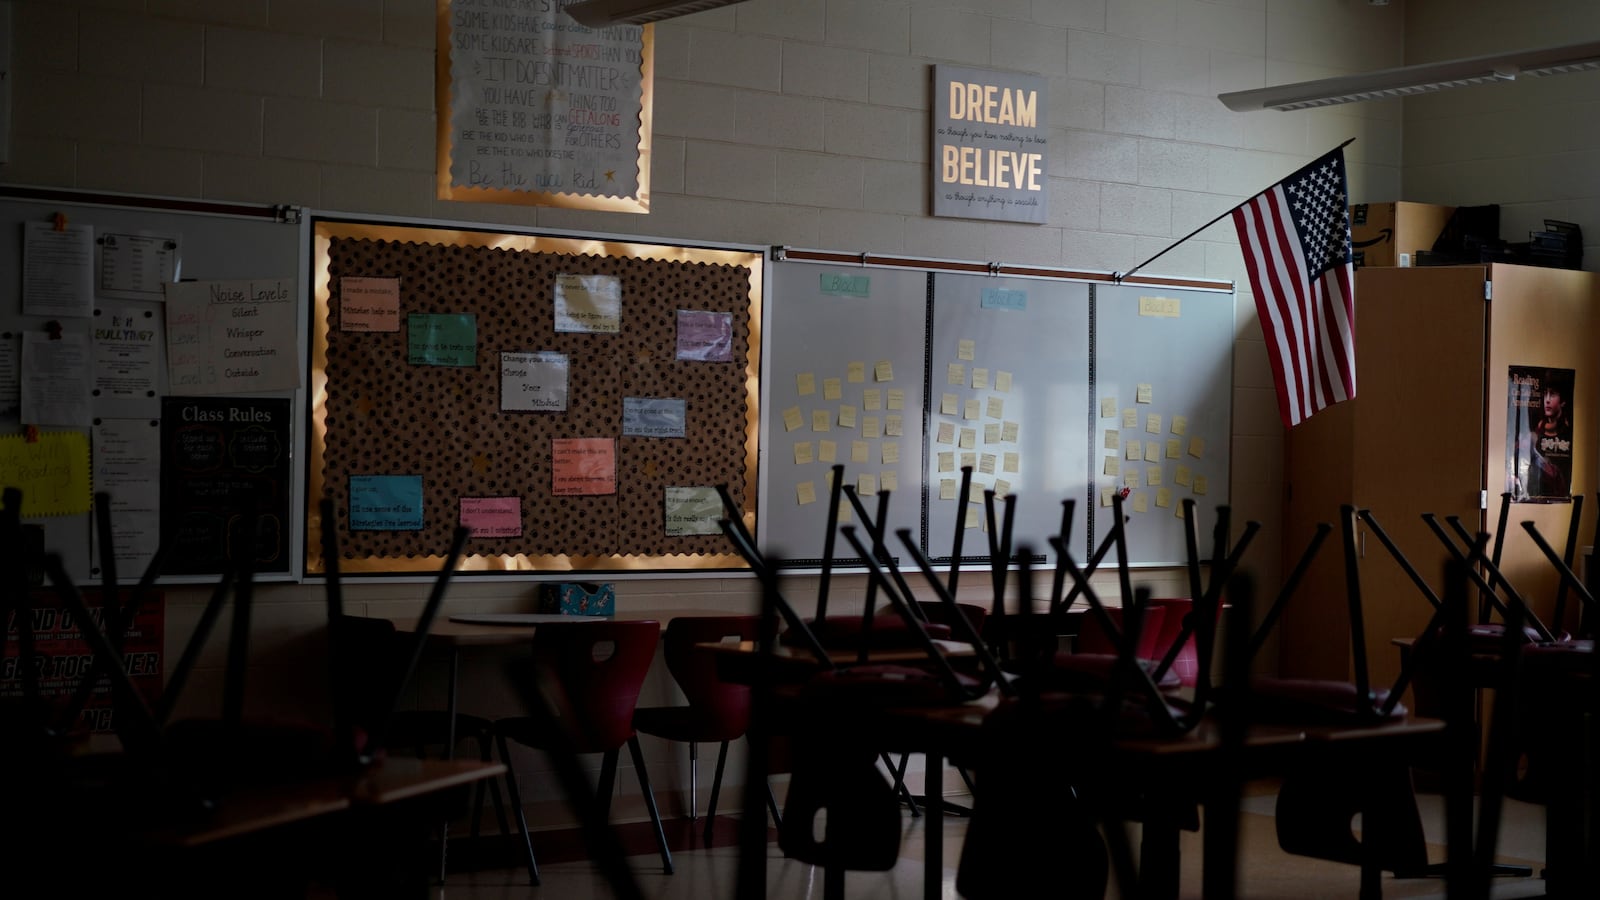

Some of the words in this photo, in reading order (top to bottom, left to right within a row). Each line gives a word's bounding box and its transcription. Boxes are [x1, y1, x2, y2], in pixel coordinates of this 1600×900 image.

[456, 10, 488, 30] SOME
[492, 14, 516, 32] KIDS
[624, 26, 641, 43] YOU
[456, 32, 488, 51] SOME
[491, 35, 515, 53] KIDS
[624, 47, 641, 65] YOU
[483, 57, 512, 82] IT
[483, 88, 501, 105] YOU
[504, 89, 536, 107] HAVE
[568, 93, 597, 112] THING
[599, 96, 616, 112] TOO
[950, 81, 1037, 128] DREAM
[587, 111, 621, 127] ALONG
[579, 133, 621, 149] OTHERS
[470, 160, 494, 185] Be
[502, 161, 529, 186] the
[573, 168, 600, 189] kid
[942, 145, 1042, 191] BELIEVE
[210, 284, 245, 303] Noise
[250, 282, 289, 302] Levels
[232, 306, 259, 318] Silent
[95, 328, 154, 341] BULLYING?
[226, 328, 265, 342] Whisper
[224, 347, 277, 359] Conversation
[503, 355, 527, 364] Change
[171, 366, 203, 386] Level
[207, 366, 217, 385] 3
[225, 368, 260, 378] Outside
[1513, 373, 1539, 390] Reading
[182, 405, 224, 422] Class
[229, 406, 272, 423] Rules
